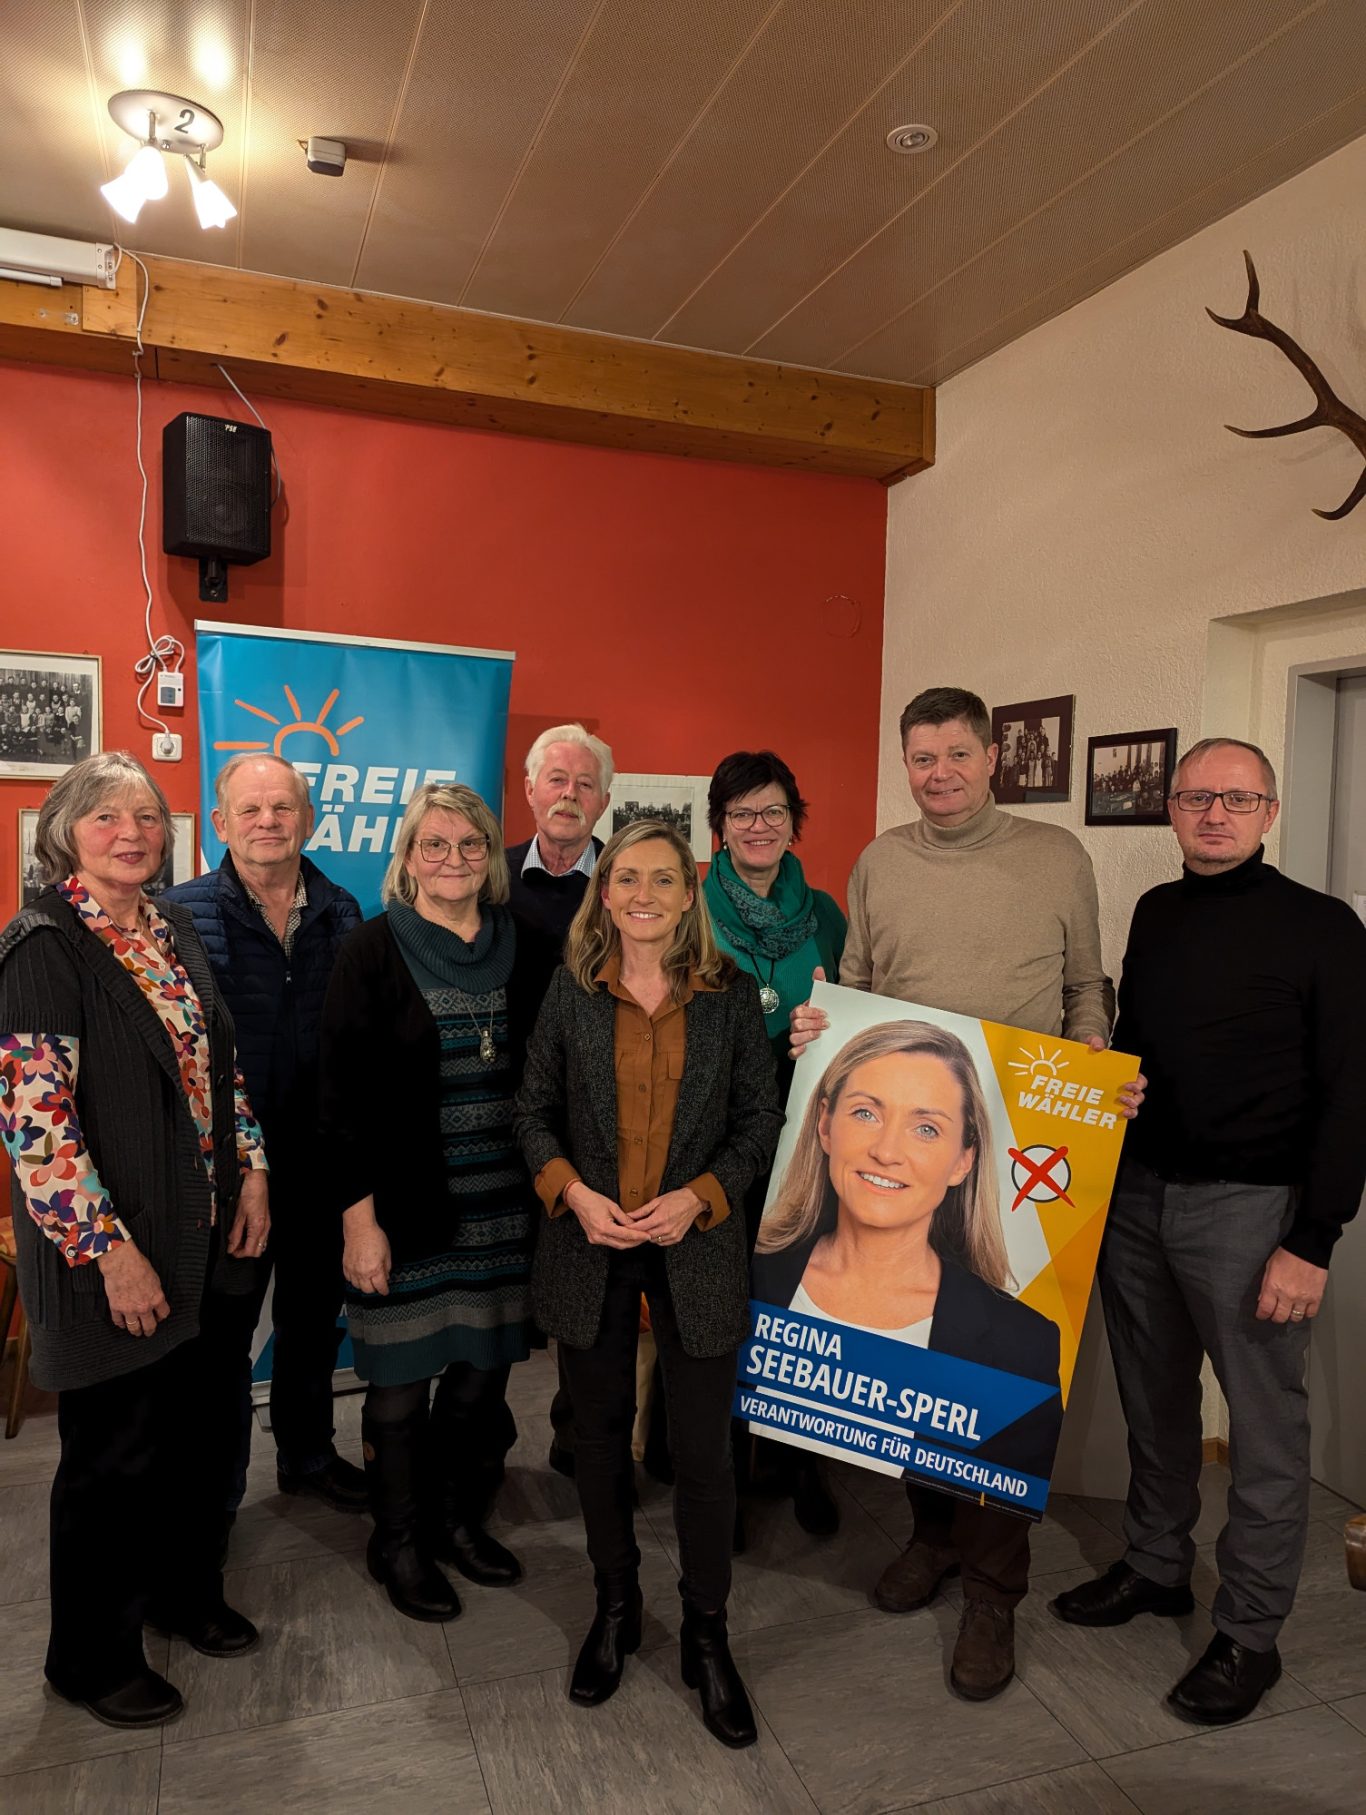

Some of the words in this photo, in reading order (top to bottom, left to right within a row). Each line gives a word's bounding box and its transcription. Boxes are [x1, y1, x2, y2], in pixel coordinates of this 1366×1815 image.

[174, 109, 195, 134] 2
[1018, 1091, 1117, 1130] WÄHLER
[1030, 1074, 1104, 1105] FREIE
[754, 1313, 841, 1360] REGINA
[746, 1344, 981, 1441] SEEBAUER-SPERL
[740, 1395, 878, 1451] VERANTWORTUNG
[880, 1436, 911, 1461] FÜR
[914, 1448, 1029, 1498] DEUTSCHLAND
